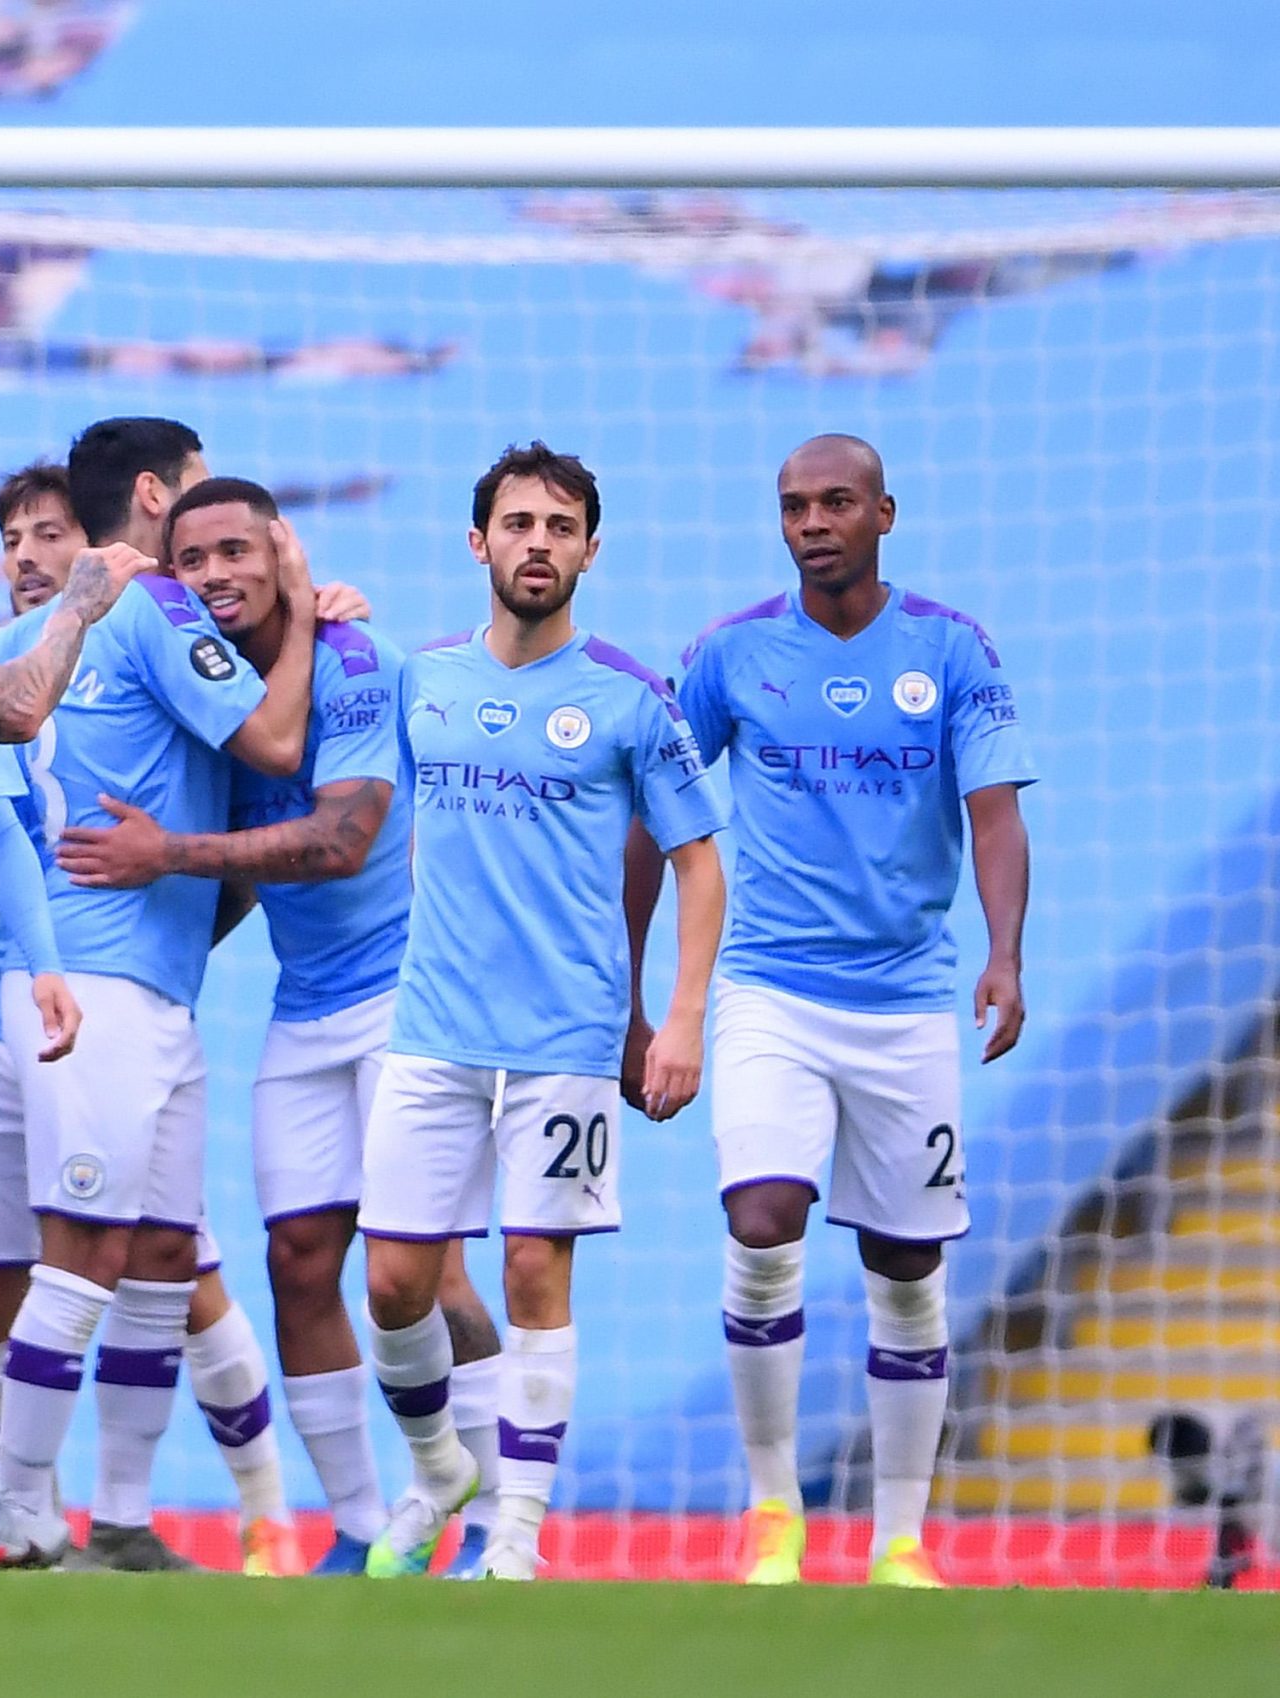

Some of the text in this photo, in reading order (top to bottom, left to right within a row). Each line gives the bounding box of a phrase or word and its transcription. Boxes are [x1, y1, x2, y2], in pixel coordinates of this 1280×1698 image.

[758, 745, 936, 771] ETIHAD
[418, 762, 576, 801] ETIHAD
[789, 778, 903, 796] AIRWAYS
[435, 796, 540, 822] AIRWAYS
[542, 1111, 608, 1178] 20
[924, 1123, 964, 1188] 2
